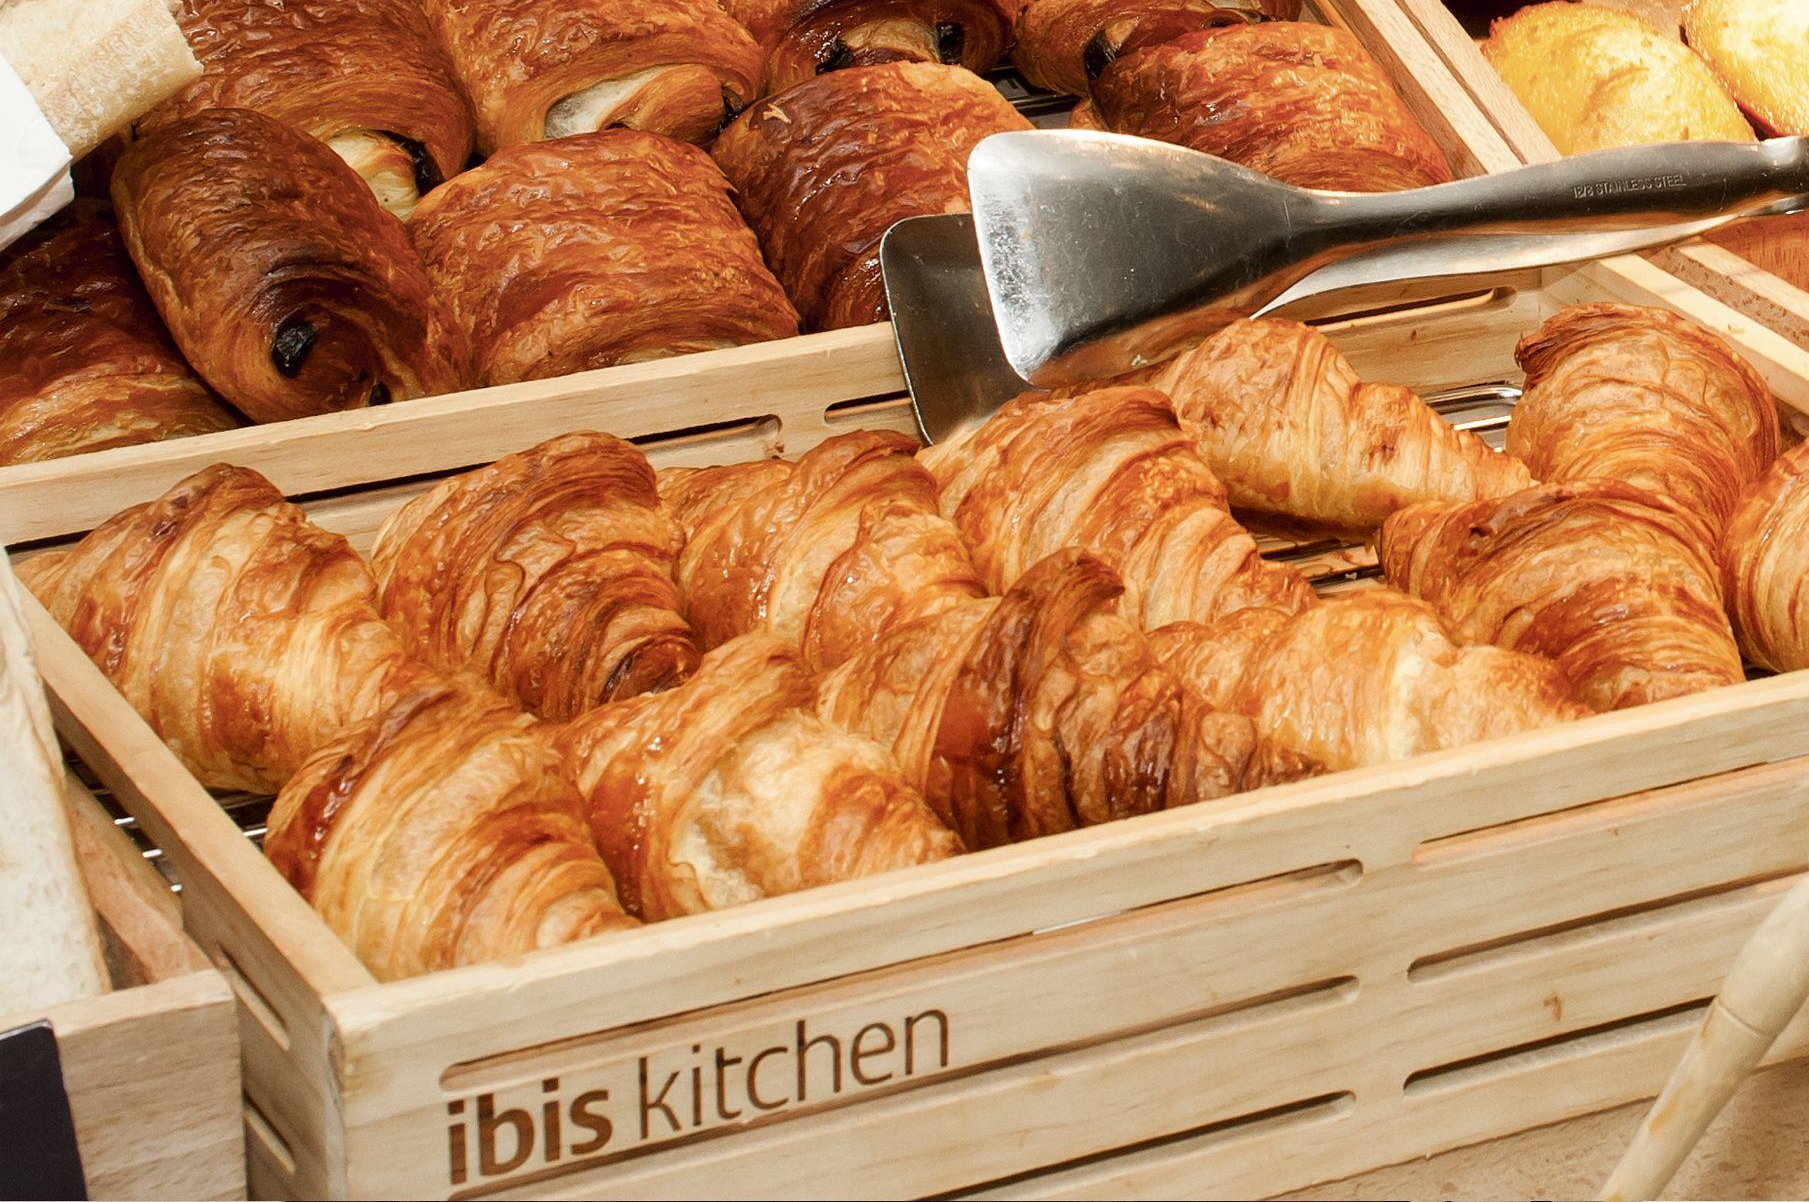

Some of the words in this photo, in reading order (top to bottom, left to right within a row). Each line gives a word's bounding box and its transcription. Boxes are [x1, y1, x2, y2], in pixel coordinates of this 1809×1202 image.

[1595, 178, 1653, 195] STAINLESS
[1654, 174, 1687, 189] STEEL
[446, 1076, 614, 1186] ibis
[637, 1007, 950, 1140] kitchen
